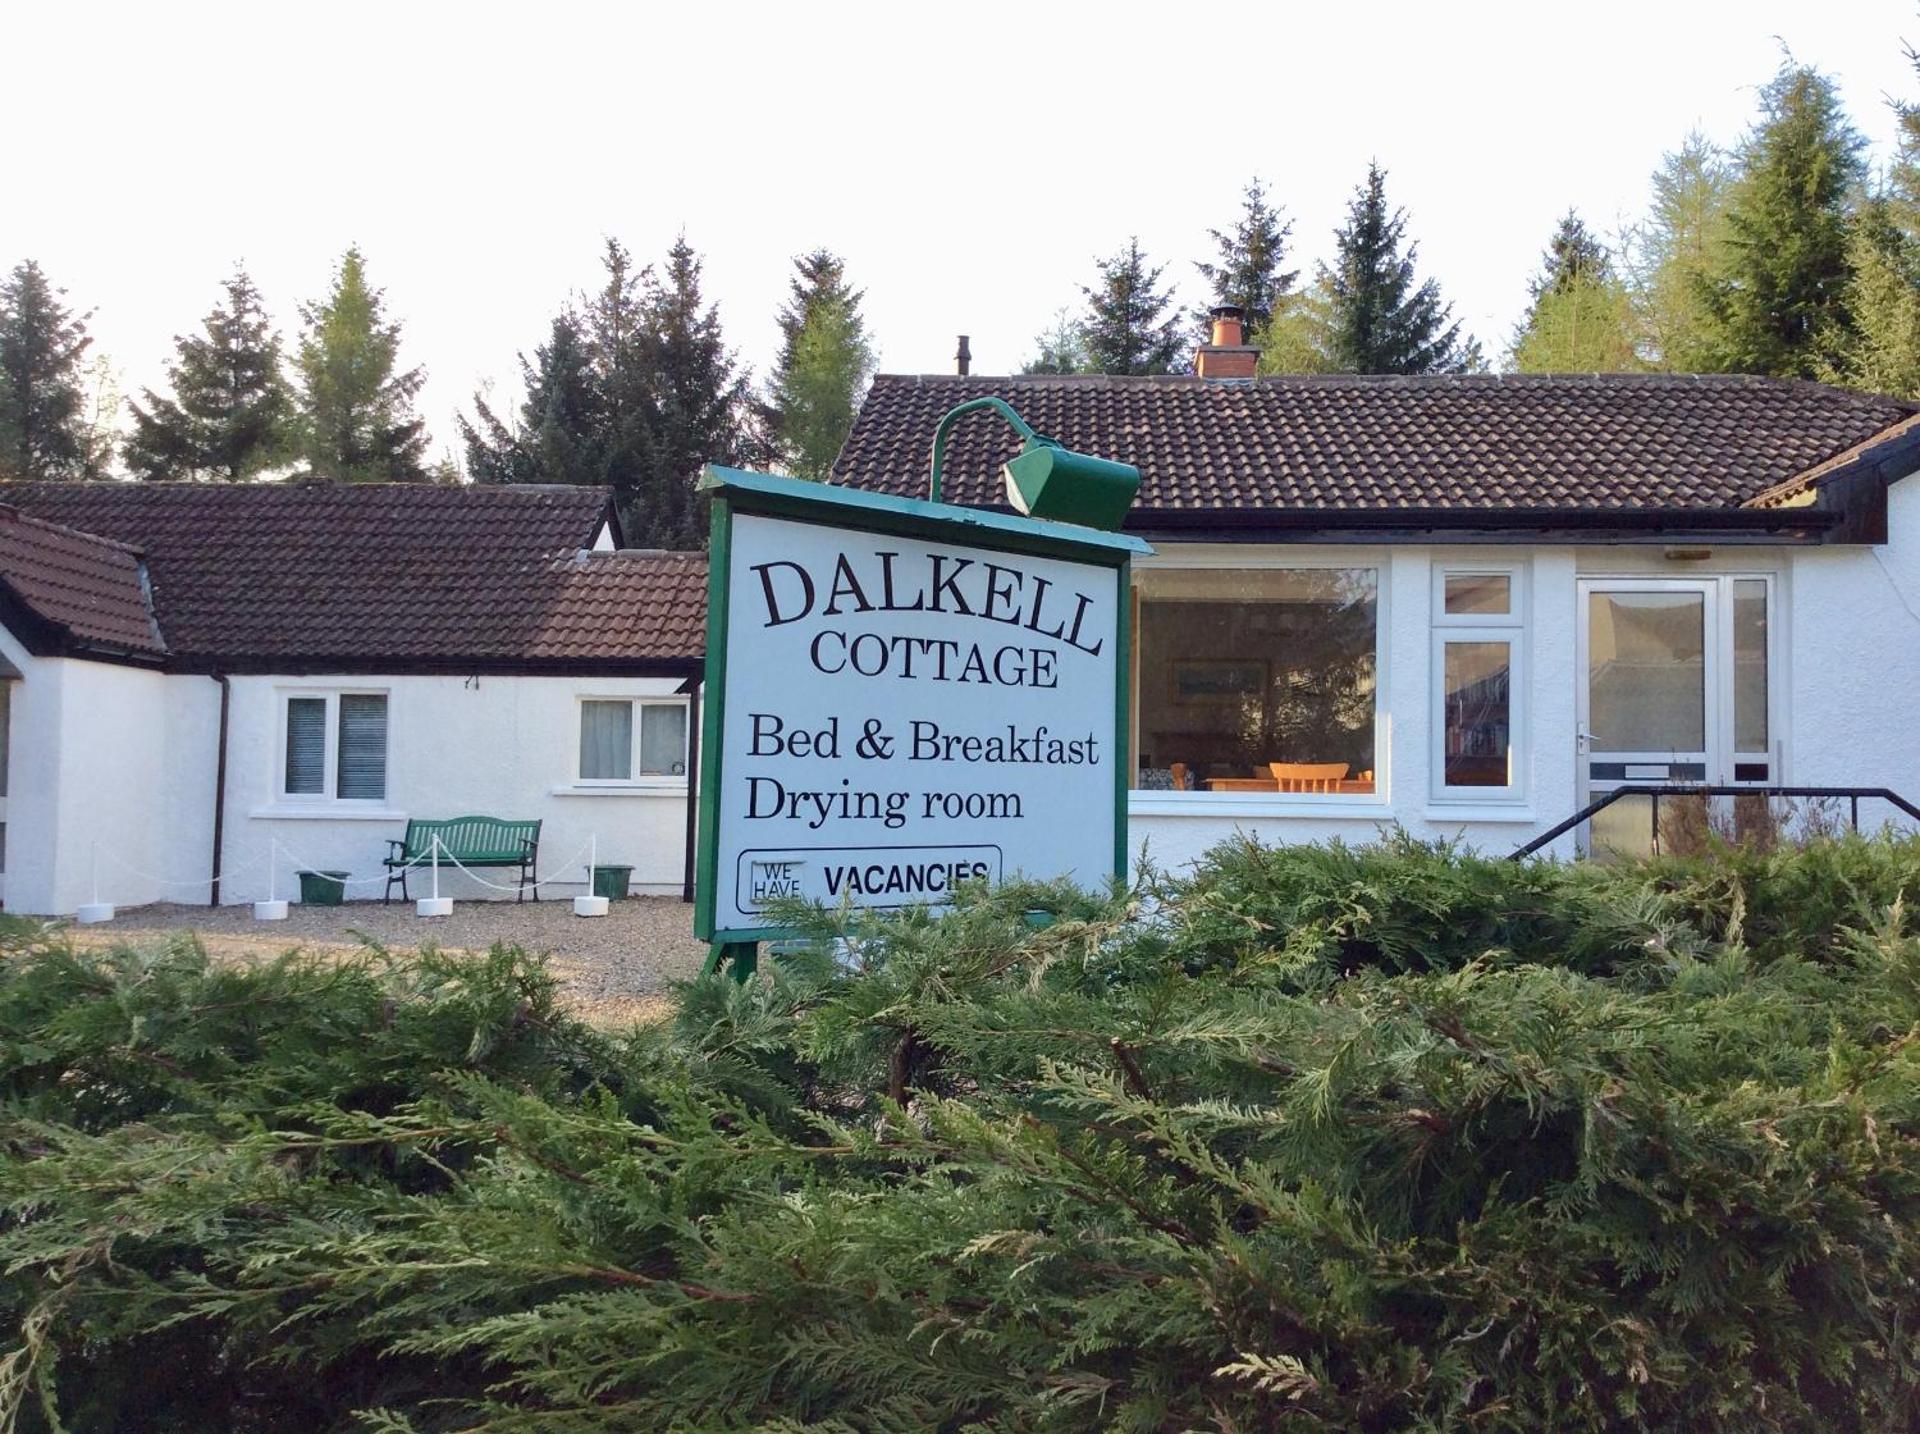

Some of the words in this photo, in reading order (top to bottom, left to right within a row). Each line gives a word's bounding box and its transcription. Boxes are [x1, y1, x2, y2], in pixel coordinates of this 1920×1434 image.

[750, 552, 1103, 657] DALKELL
[810, 630, 1058, 689] COTTAGE
[747, 714, 841, 758] Bed
[856, 718, 895, 760] &
[908, 720, 1099, 765] Breakfast
[744, 777, 910, 829] Drying
[922, 791, 1024, 818] room
[754, 880, 800, 898] HAVE
[764, 863, 792, 880] WE
